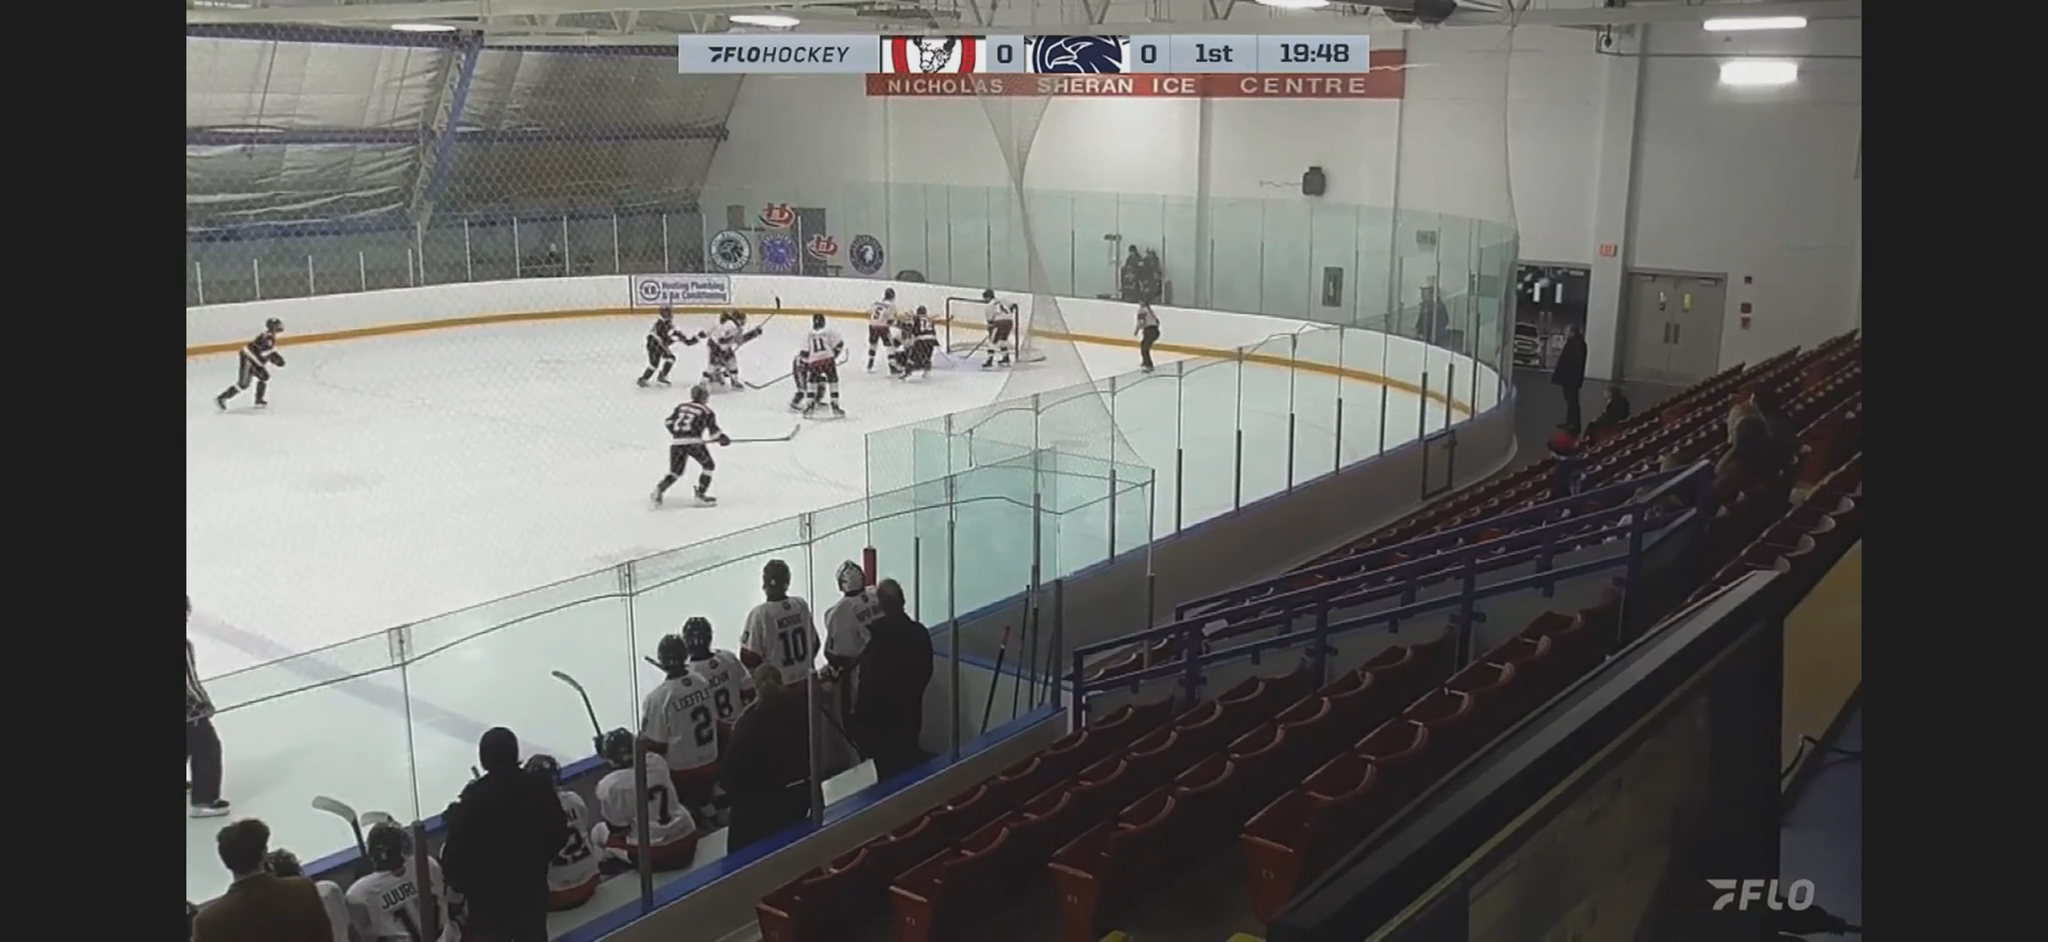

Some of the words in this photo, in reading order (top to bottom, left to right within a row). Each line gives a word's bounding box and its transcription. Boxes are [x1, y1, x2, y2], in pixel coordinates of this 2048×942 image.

[887, 77, 1004, 94] NICHOLAS
[1037, 77, 1134, 94] SHERAN
[1153, 77, 1196, 94] ICE
[1240, 77, 1366, 95] CENTRE
[812, 338, 825, 353] 11
[778, 626, 808, 667] 10
[691, 704, 715, 748] 2
